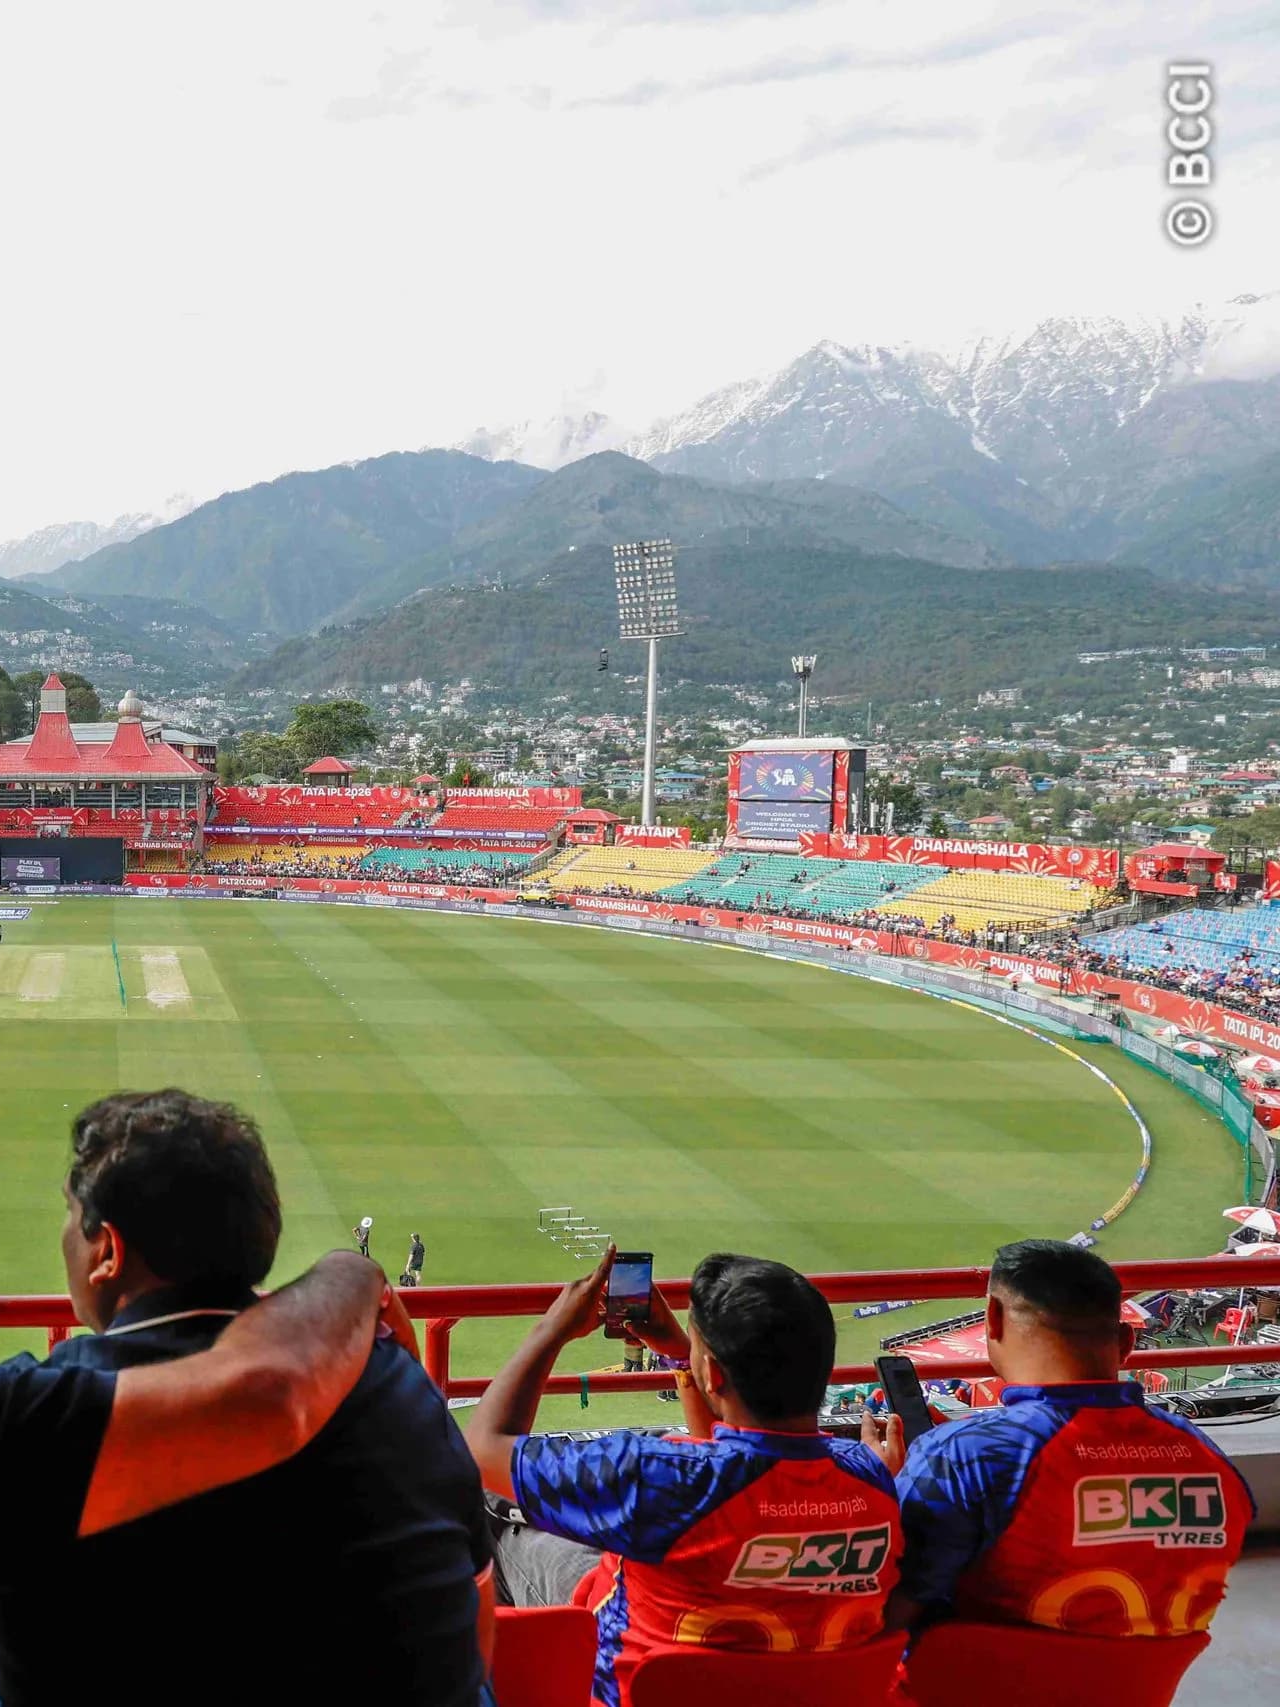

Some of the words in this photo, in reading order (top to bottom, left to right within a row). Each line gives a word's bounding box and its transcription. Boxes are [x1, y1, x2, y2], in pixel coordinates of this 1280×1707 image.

[302, 788, 325, 797] TATA
[327, 788, 342, 797] IPL
[345, 788, 372, 797] 2026
[447, 789, 529, 798] DHARAMSHALA
[624, 826, 682, 838] #TATAIPL
[480, 839, 500, 848] TATA
[501, 840, 514, 848] IPL
[913, 839, 1029, 858] DHARAMSHALA
[218, 878, 266, 888] IPLT20.COM
[387, 884, 408, 893] TATA
[409, 886, 422, 895] IPL
[576, 897, 649, 914] DHARAMSHALA
[794, 922, 832, 937] JEETNA
[834, 928, 853, 940] HAI
[1223, 1014, 1248, 1038] TATA
[1250, 1022, 1266, 1044] IPL
[1075, 1443, 1193, 1464] #saddapanjab
[758, 1497, 868, 1521] #saddapanjab
[1082, 1486, 1219, 1523] BKT
[1157, 1531, 1225, 1546] TYRES
[741, 1536, 887, 1572] BKT
